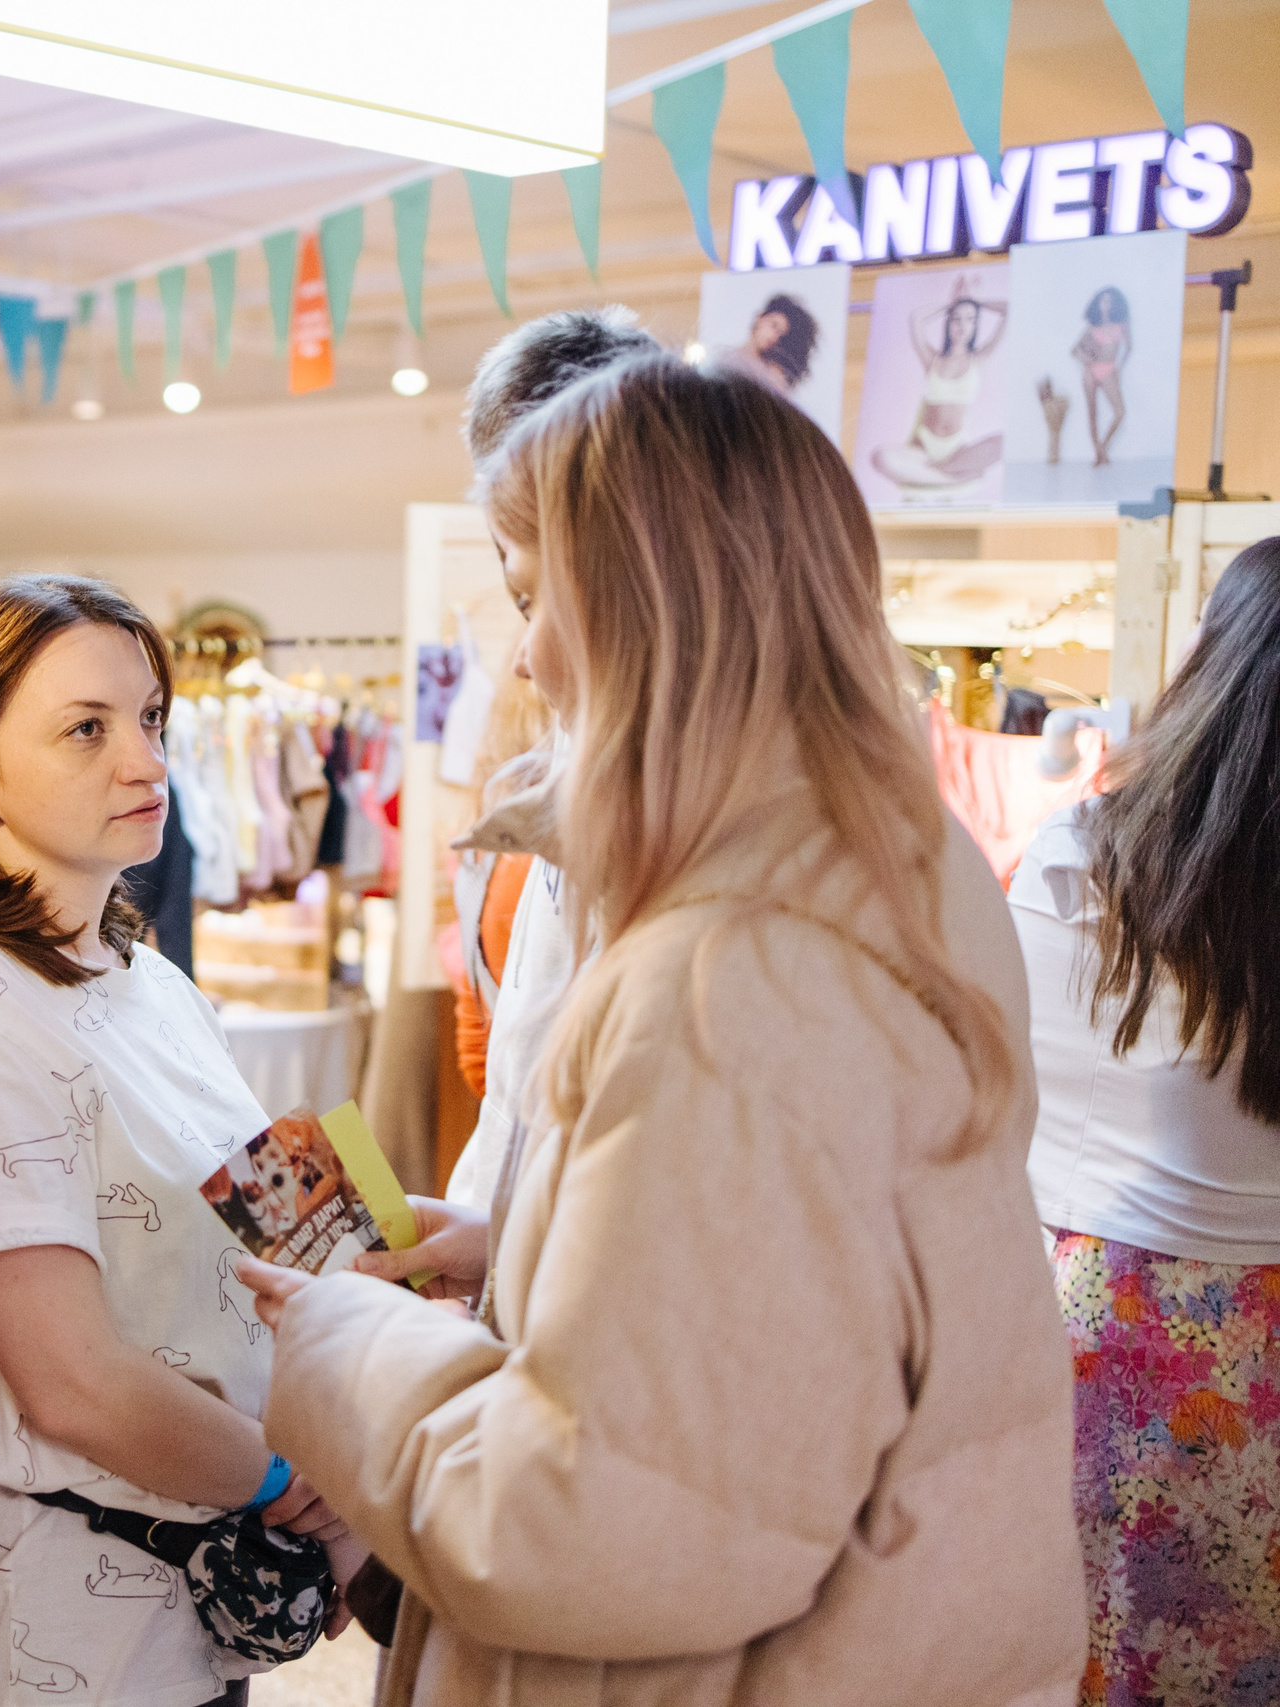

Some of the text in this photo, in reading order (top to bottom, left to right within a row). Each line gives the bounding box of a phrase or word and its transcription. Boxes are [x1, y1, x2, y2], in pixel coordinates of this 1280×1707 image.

[728, 121, 1238, 272] KANIVETS
[311, 1194, 346, 1233] ДАРИТ
[301, 1215, 354, 1271] СКИДКУ 10%
